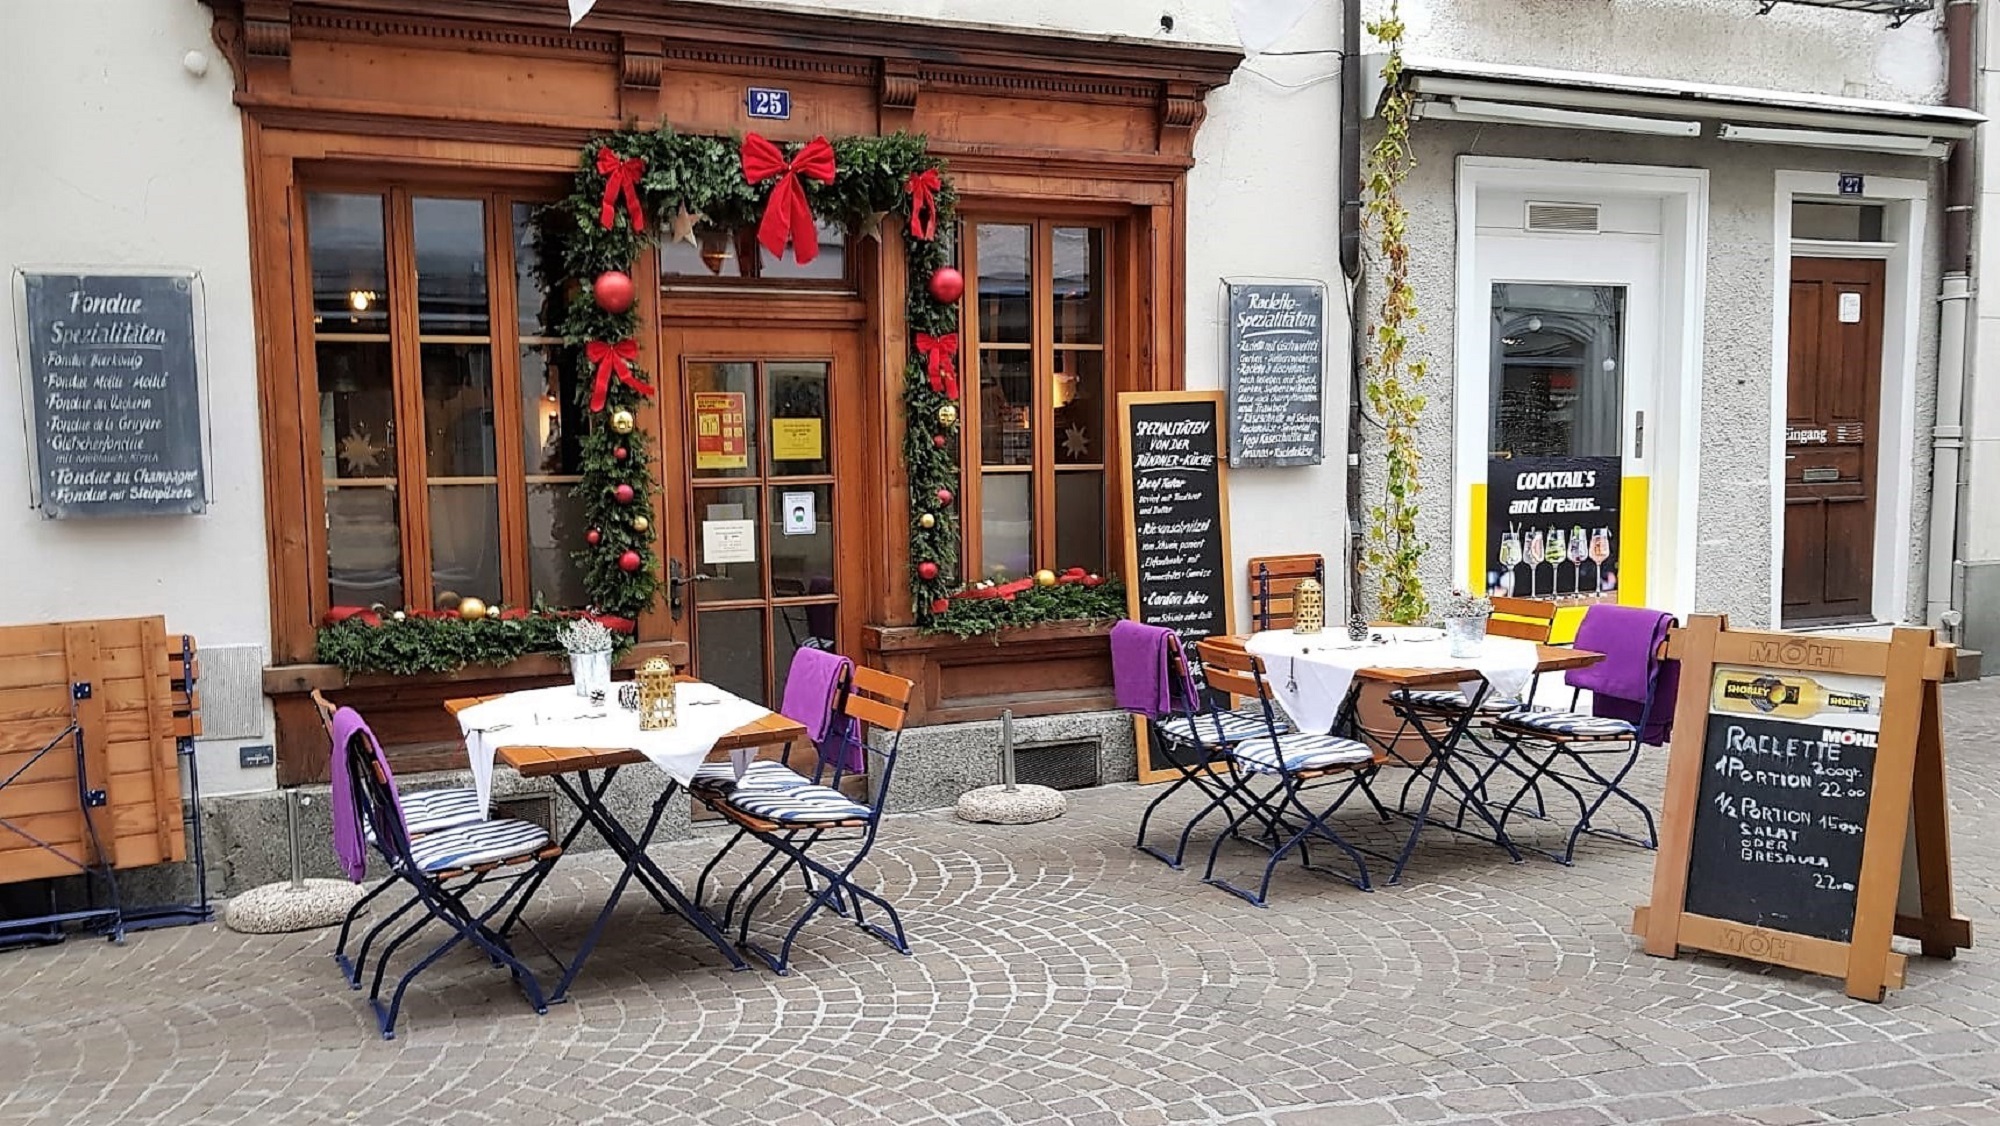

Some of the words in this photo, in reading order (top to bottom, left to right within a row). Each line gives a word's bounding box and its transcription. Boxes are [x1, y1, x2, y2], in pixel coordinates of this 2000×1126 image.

[756, 92, 782, 114] 25
[1845, 177, 1860, 192] 27
[69, 290, 143, 314] Fondue
[1237, 311, 1316, 334] Spezialitäten
[51, 321, 167, 348] Spezialitäten
[47, 350, 87, 366] Fondue
[48, 372, 87, 389] Fondue
[49, 393, 91, 410] Fondue
[51, 415, 91, 432] Fondue
[1136, 419, 1210, 436] SPEZIALITÄTEN
[52, 433, 144, 452] Gletscherfondue
[1149, 439, 1169, 451] VON
[1169, 438, 1190, 451] DER
[56, 467, 111, 485] Fondue
[113, 471, 130, 485] au
[134, 467, 198, 486] Champagne
[1139, 477, 1161, 491] Beef
[56, 487, 107, 503] Fondue
[1508, 496, 1539, 514] and
[1147, 591, 1183, 606] Cordon
[1727, 684, 1771, 697] SHORLEY
[1830, 697, 1868, 708] SHORLEY
[1726, 725, 1842, 762] RACLETTE
[1822, 728, 1878, 748] MÖHL
[1728, 757, 1812, 788] PORTION
[1819, 782, 1866, 798] 22.00
[1741, 797, 1812, 827] PORTION
[1739, 822, 1799, 842] SALAT
[1741, 838, 1788, 852] ODER
